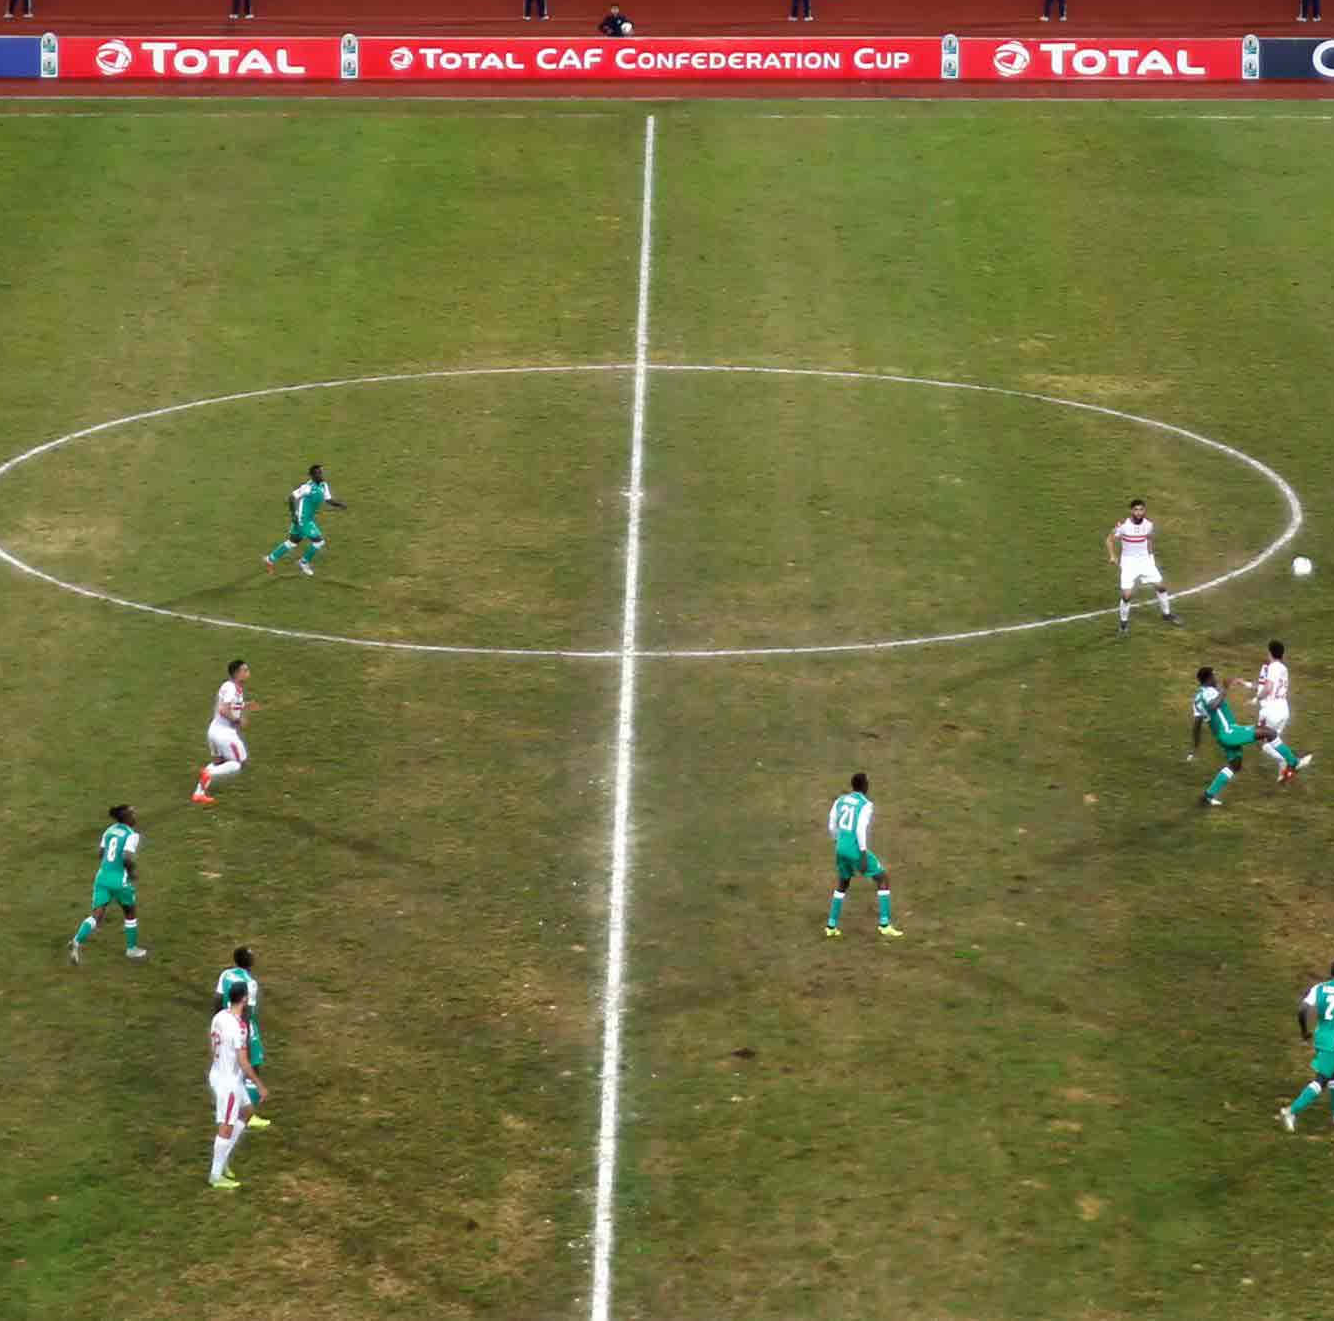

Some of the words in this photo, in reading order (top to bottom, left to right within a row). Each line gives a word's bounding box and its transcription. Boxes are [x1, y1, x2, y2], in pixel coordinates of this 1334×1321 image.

[140, 42, 306, 75] TOTAL
[418, 48, 525, 71] TOTAL
[535, 47, 603, 71] CAF
[853, 47, 910, 71] CUP
[1039, 42, 1207, 76] TOTAL
[839, 805, 855, 830] 21
